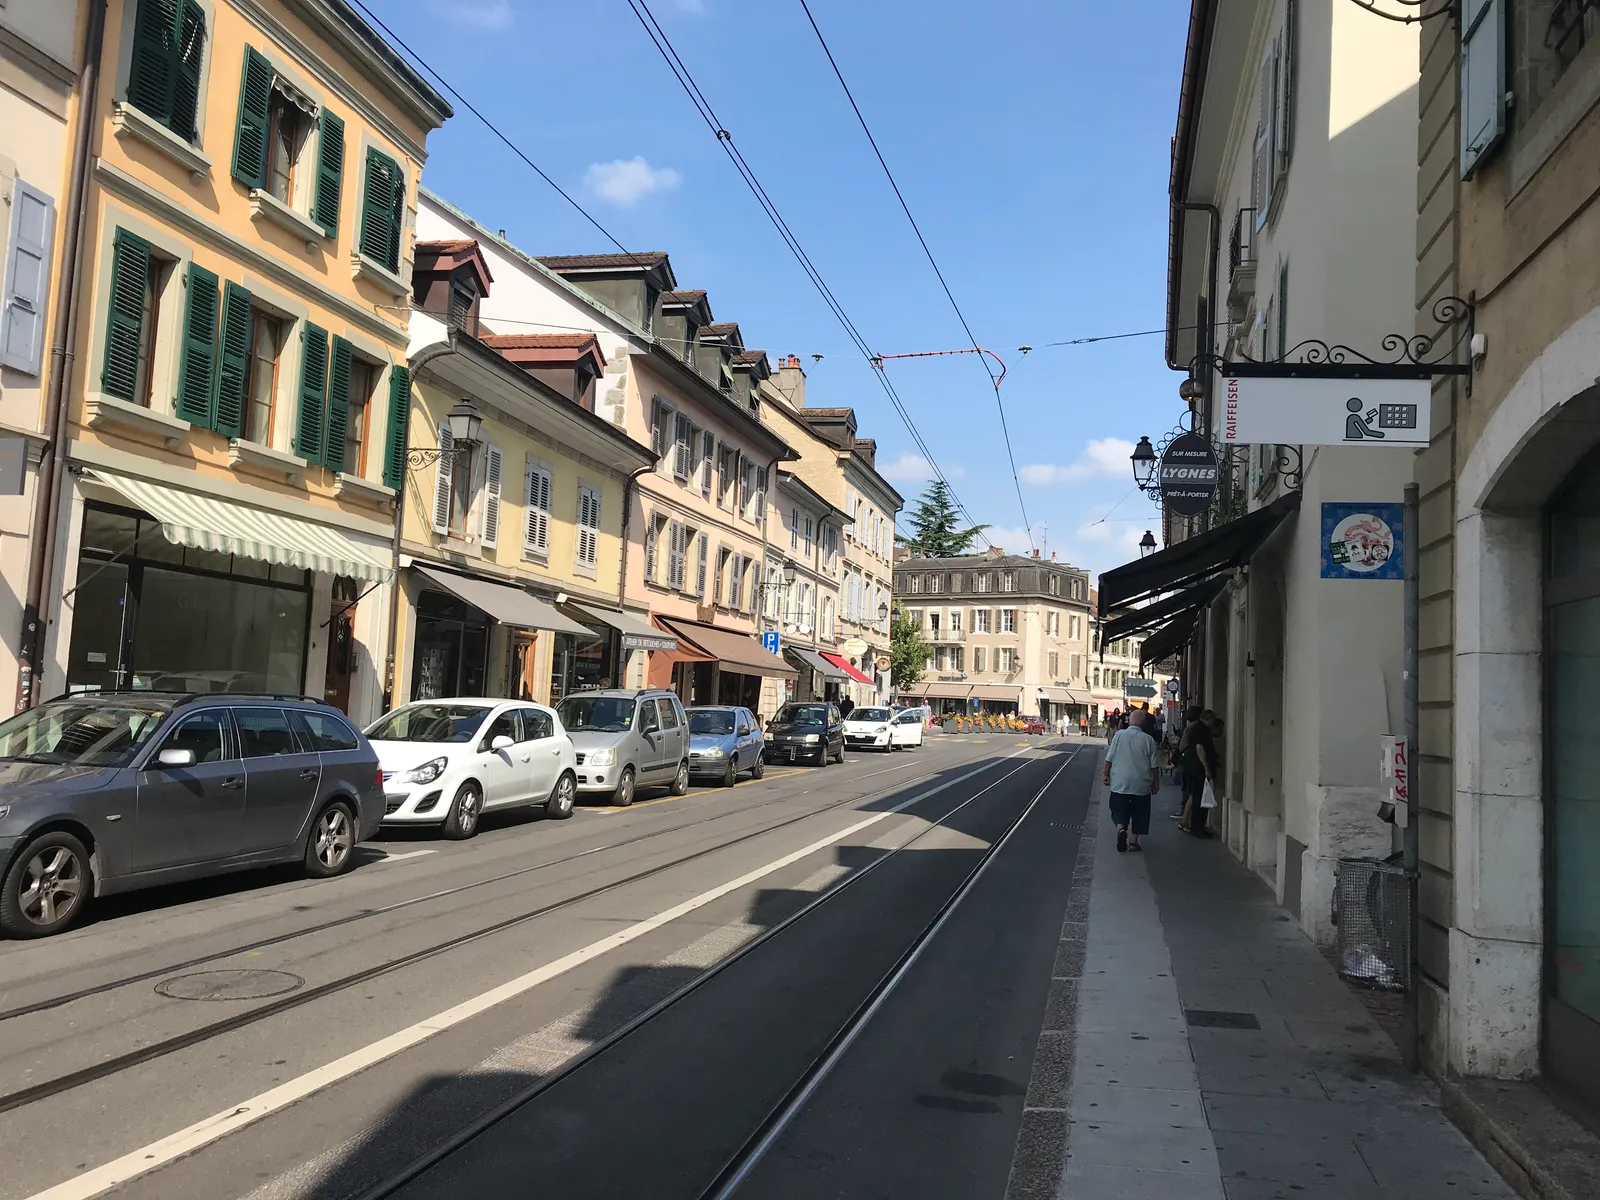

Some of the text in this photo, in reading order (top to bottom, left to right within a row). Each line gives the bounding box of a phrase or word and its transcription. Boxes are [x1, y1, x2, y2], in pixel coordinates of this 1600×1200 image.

[1226, 379, 1239, 440] RAIFFEISEN
[1162, 468, 1216, 479] LYGNES
[767, 634, 775, 645] P
